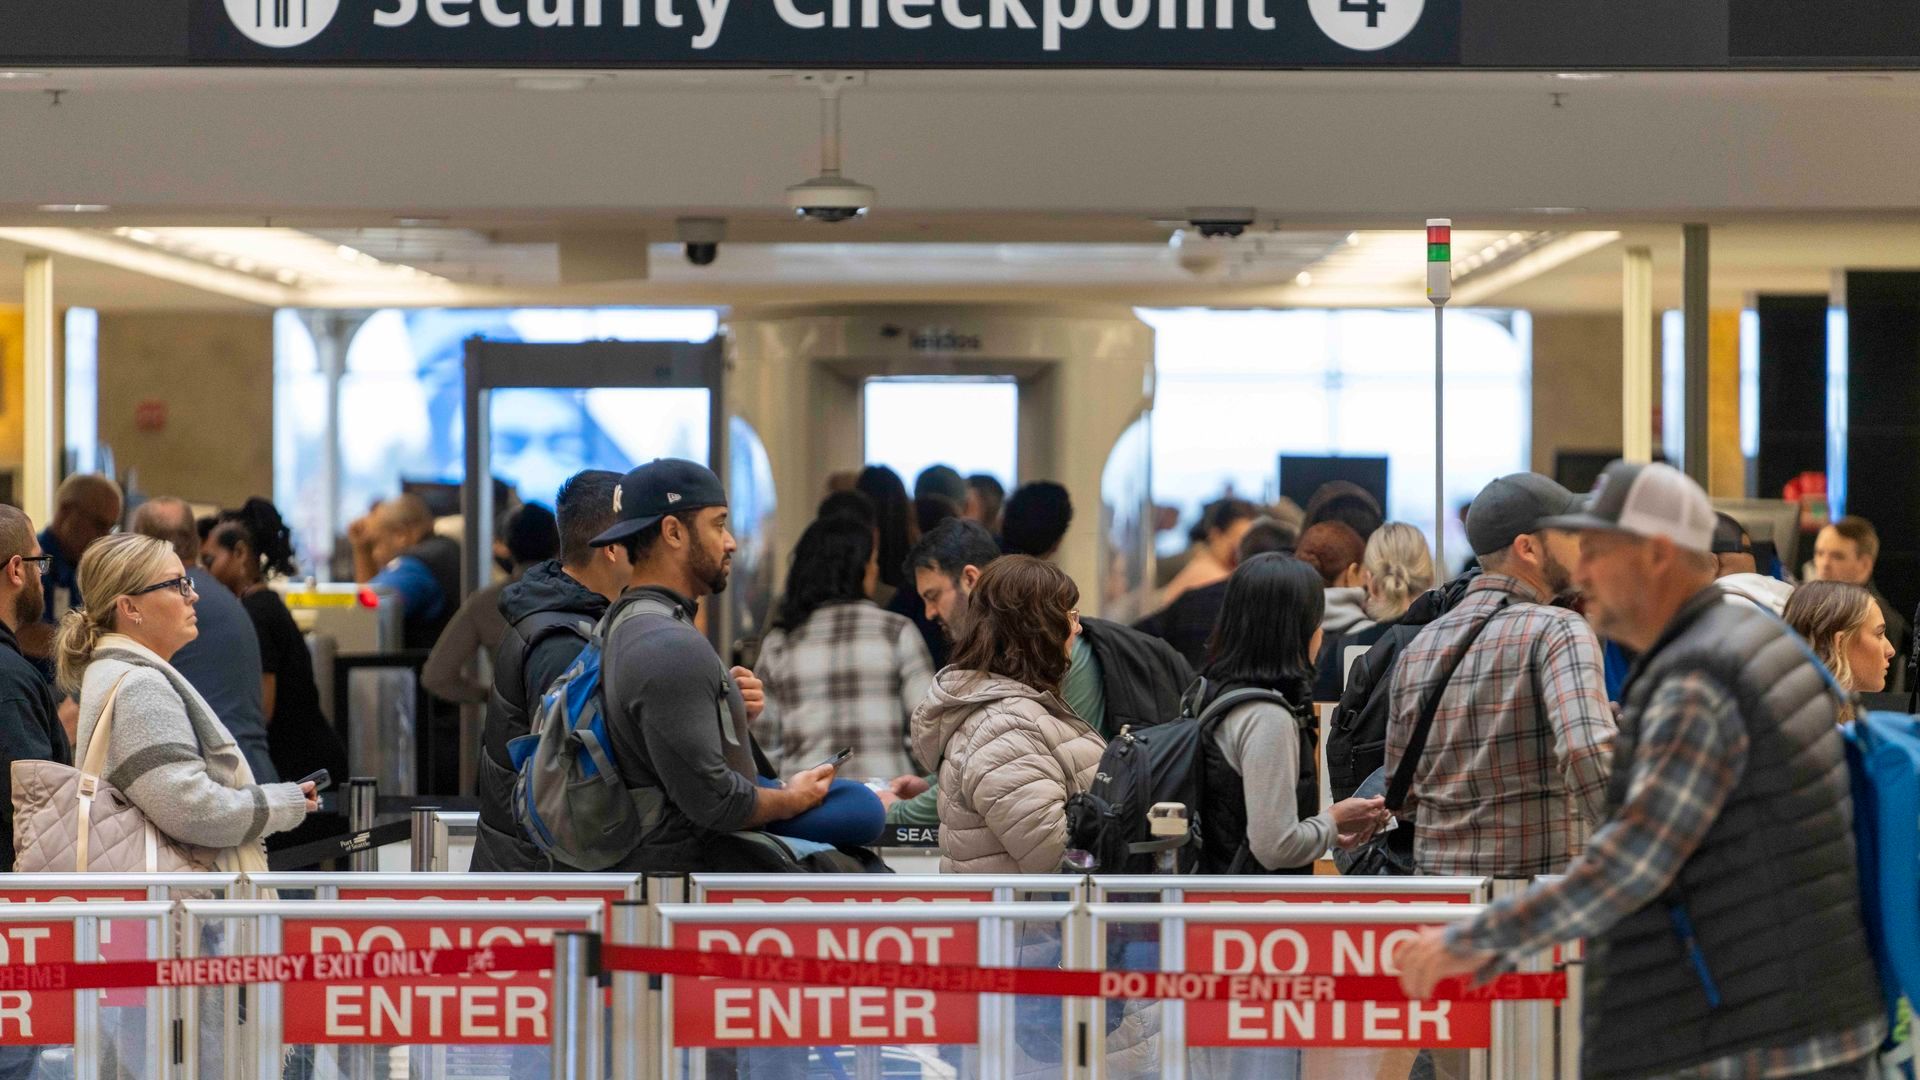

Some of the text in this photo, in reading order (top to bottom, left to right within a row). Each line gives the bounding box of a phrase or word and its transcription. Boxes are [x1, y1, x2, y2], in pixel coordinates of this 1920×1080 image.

[896, 828, 934, 841] SEA
[817, 927, 954, 965] NOT
[1213, 929, 1422, 976] DO NO
[157, 949, 437, 985] EMERGENCY EXIT ONLY
[1101, 972, 1335, 1001] DO NOT ENTER
[325, 986, 549, 1037] ENTER
[714, 986, 937, 1039] ENTER
